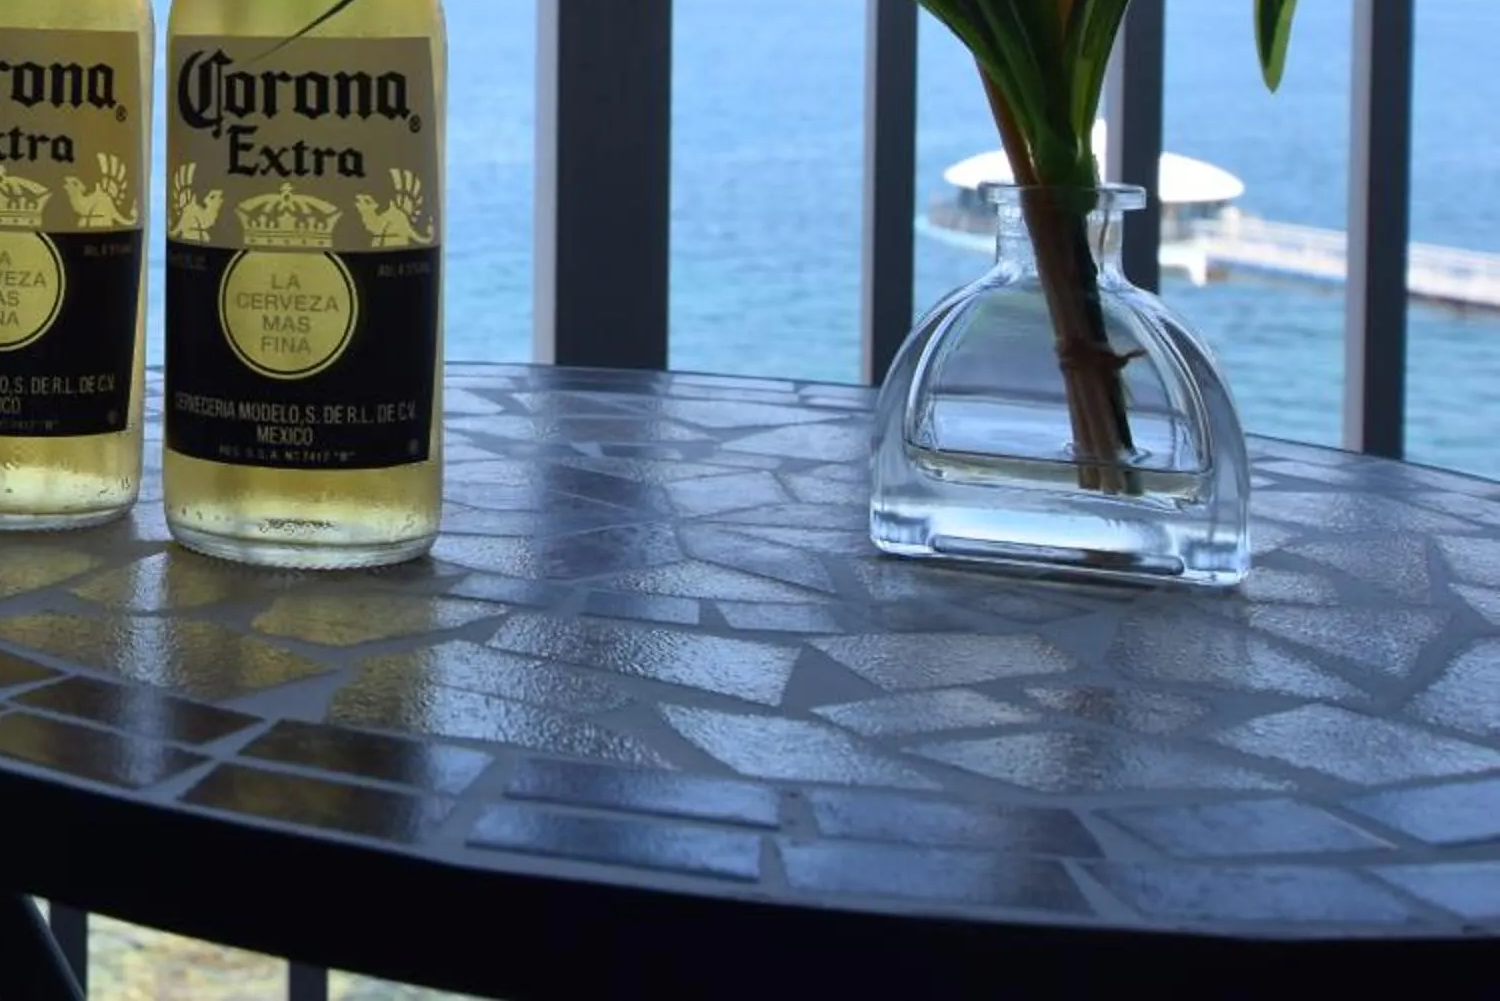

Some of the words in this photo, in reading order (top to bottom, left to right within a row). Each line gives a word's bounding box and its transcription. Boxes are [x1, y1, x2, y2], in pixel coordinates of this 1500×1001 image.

[178, 49, 411, 139] Corona
[226, 125, 366, 177] Extra
[271, 273, 301, 290] LA
[236, 293, 339, 313] CERVEZA
[262, 314, 311, 334] MAS
[260, 335, 312, 354] FINA
[31, 374, 49, 394] DE
[323, 404, 345, 424] DE
[377, 403, 396, 423] DE
[256, 424, 314, 446] MEXICO
